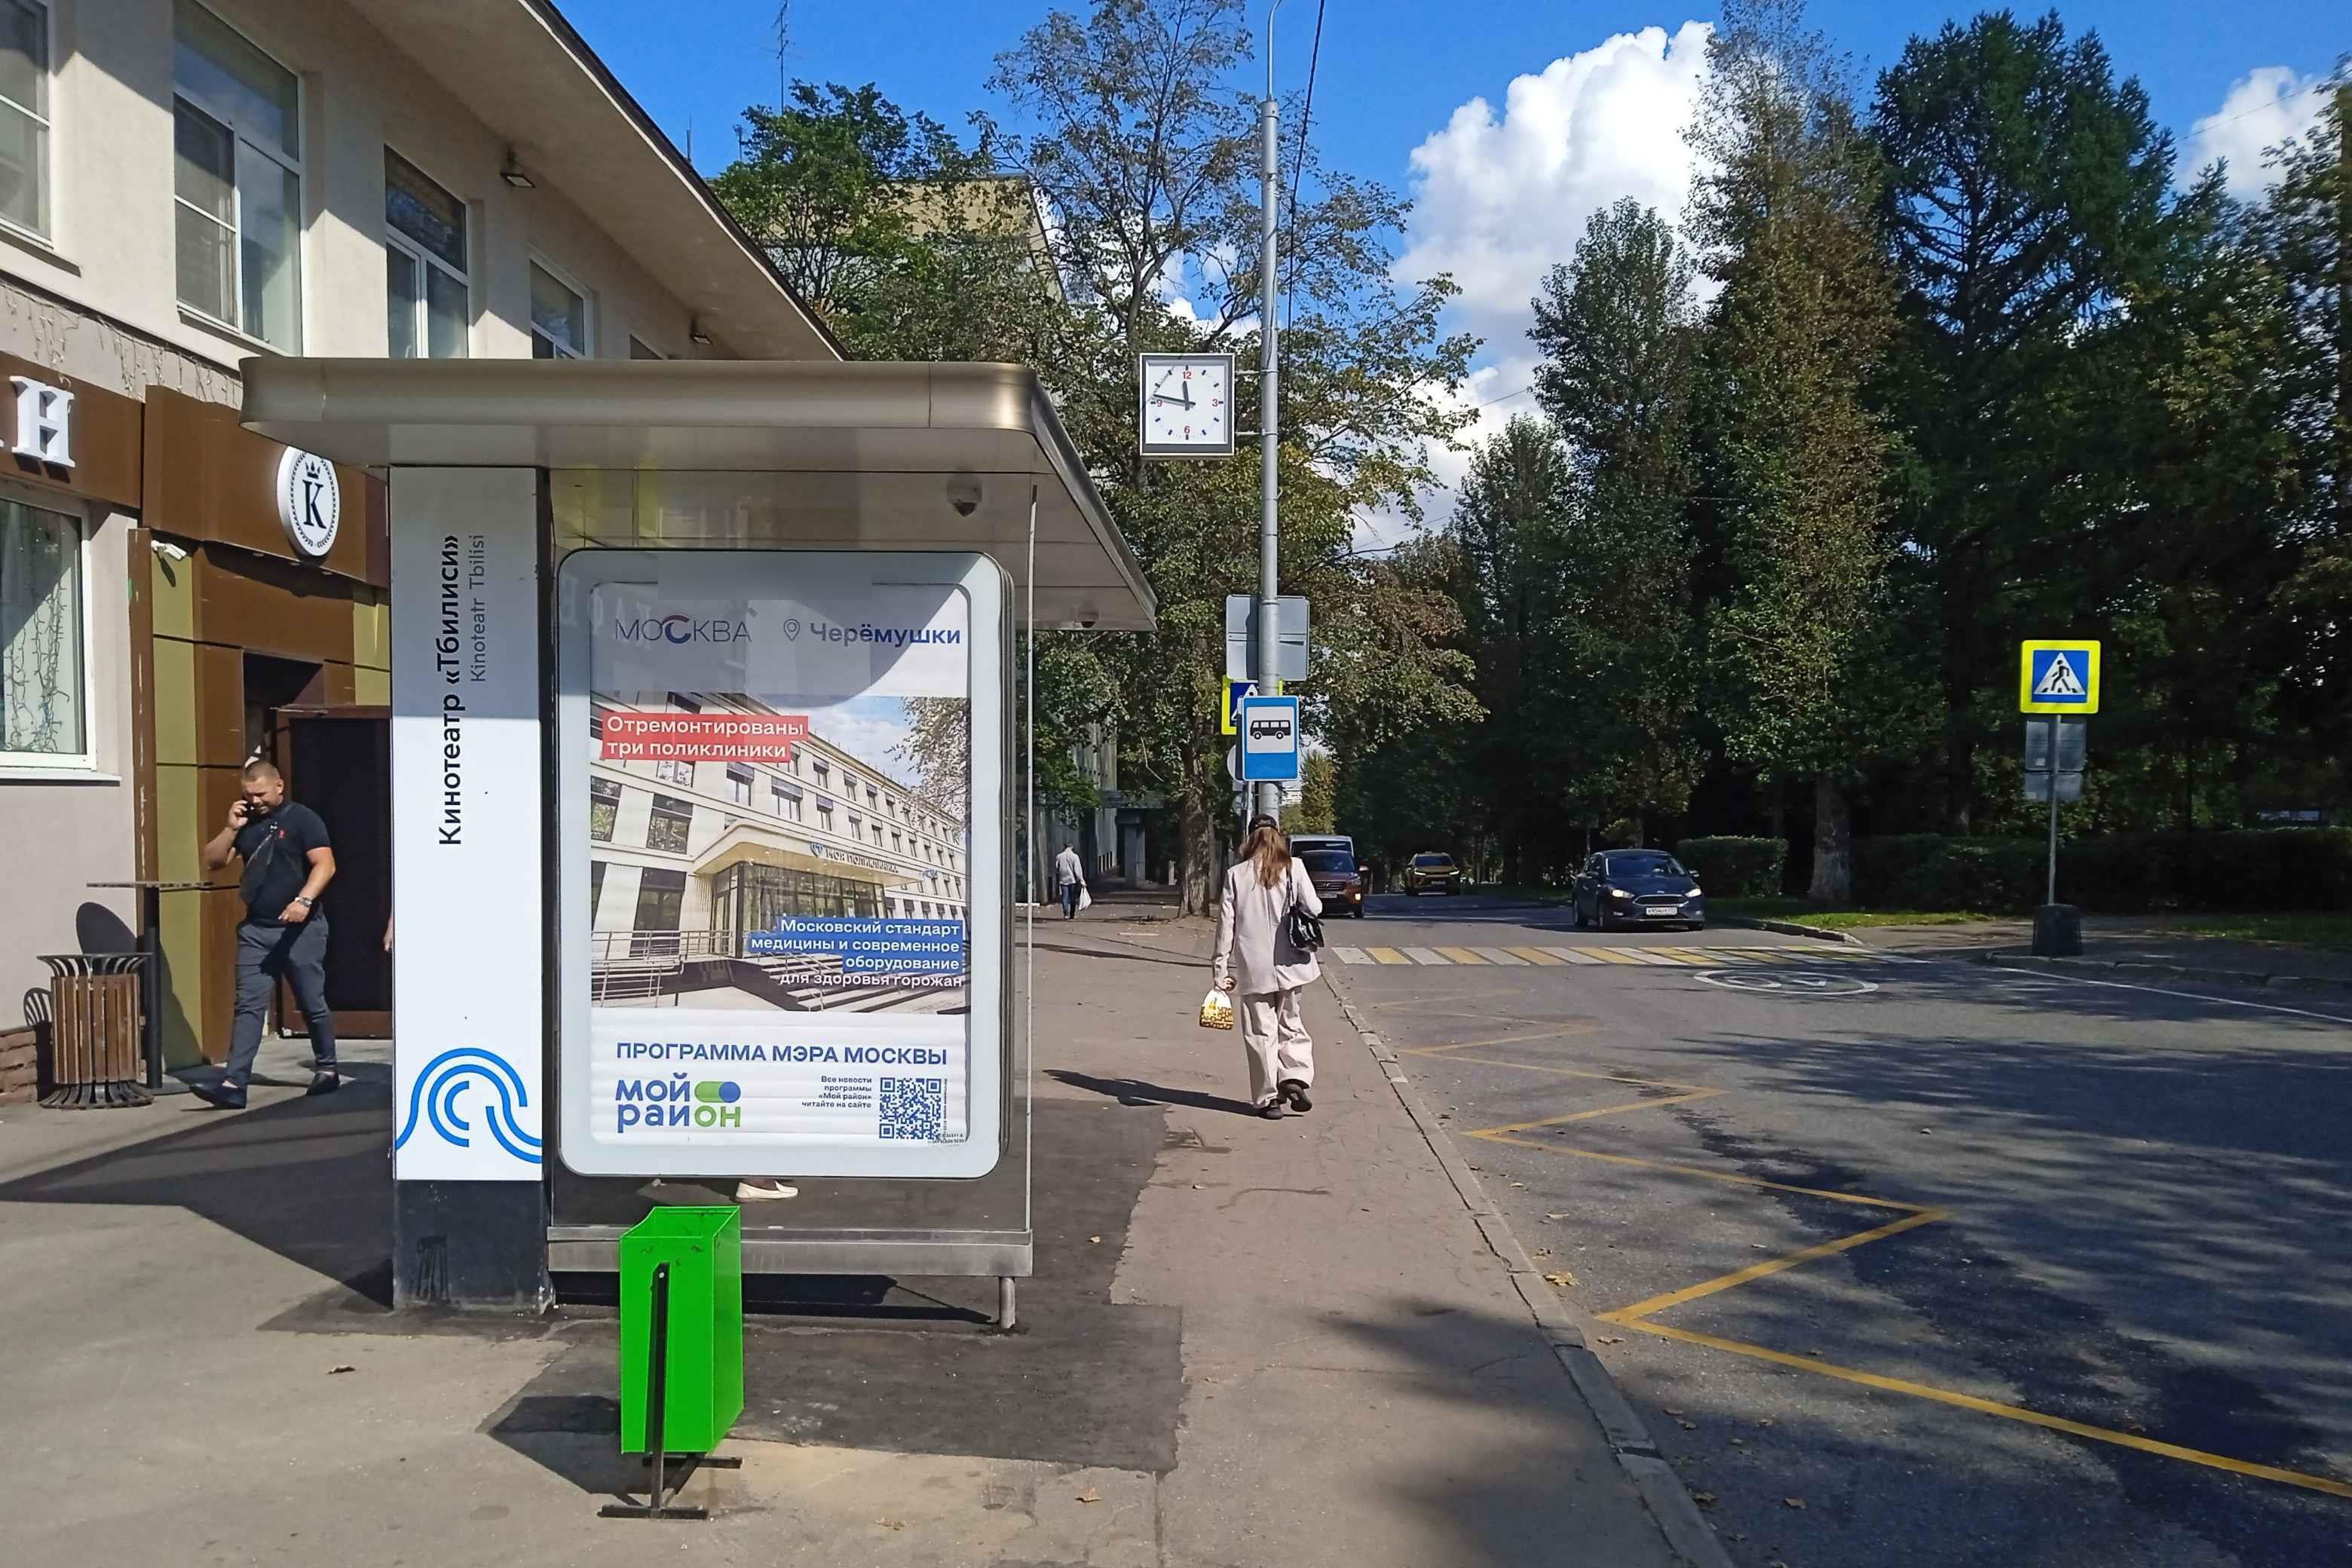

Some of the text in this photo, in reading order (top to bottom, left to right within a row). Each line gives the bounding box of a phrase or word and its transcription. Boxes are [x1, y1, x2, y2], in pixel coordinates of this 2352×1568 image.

[1182, 371, 1192, 379] 12
[1156, 399, 1162, 407] 9
[1211, 398, 1218, 407] 3
[0, 375, 75, 468] Н
[1184, 425, 1190, 434] 6
[467, 534, 486, 682] Kinoteatr Tbilisi
[614, 614, 753, 645] МОСКВА
[810, 622, 961, 648] Черёмушки
[436, 534, 466, 845] Кинотеатр «Тбилиси»
[607, 715, 804, 737] Отремонтированы
[607, 742, 786, 758] три поликлиники
[781, 919, 960, 936] Московский стандарт
[751, 939, 960, 953] медицины и современное
[845, 955, 960, 971] оборудование
[779, 973, 963, 988] для здоровья горожан
[616, 1043, 948, 1065] ПРОГРАММА МЭРА МОСКВЫ
[615, 1072, 691, 1102] мой
